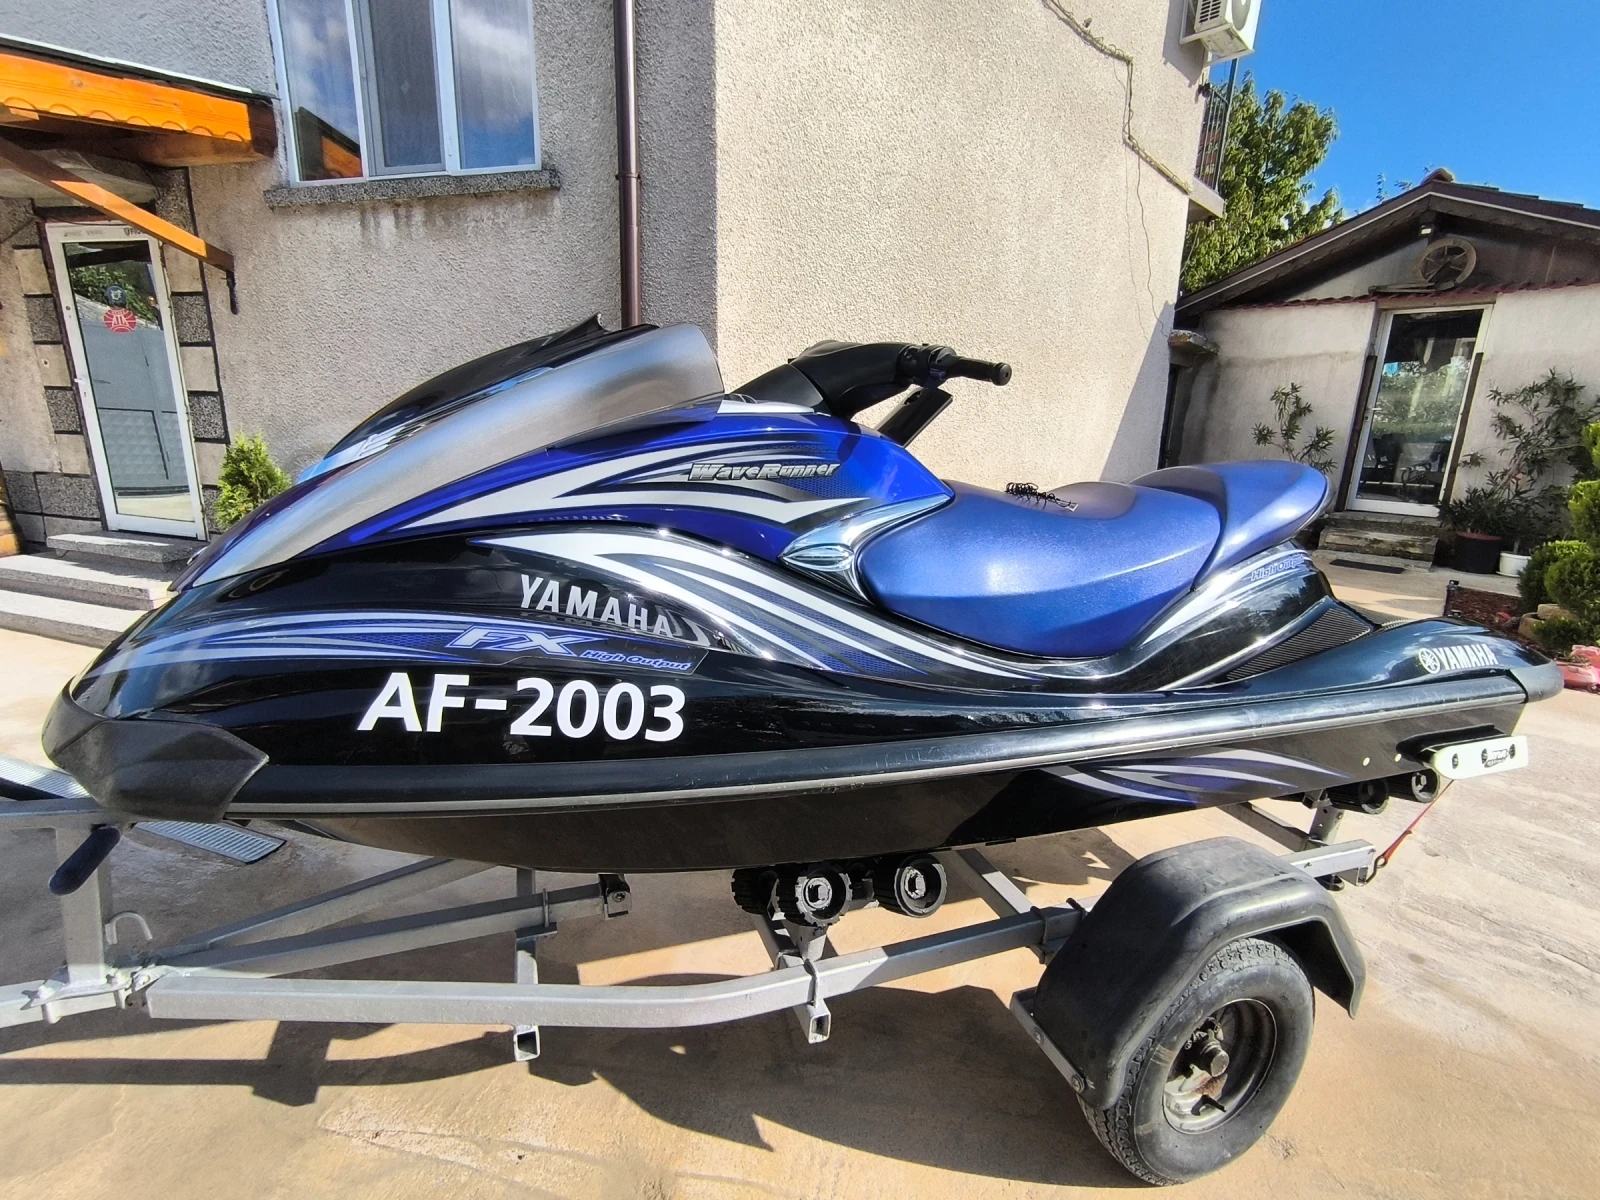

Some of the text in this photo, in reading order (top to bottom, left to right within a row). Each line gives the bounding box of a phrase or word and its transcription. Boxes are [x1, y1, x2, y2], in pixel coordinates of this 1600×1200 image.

[688, 463, 841, 481] WaveRunner
[1250, 564, 1276, 582] High
[520, 574, 674, 638] YAMAHA
[446, 625, 590, 656] FX
[580, 649, 693, 671] High Output
[1432, 643, 1499, 671] YAMAHA
[356, 672, 686, 742] AF-2003
